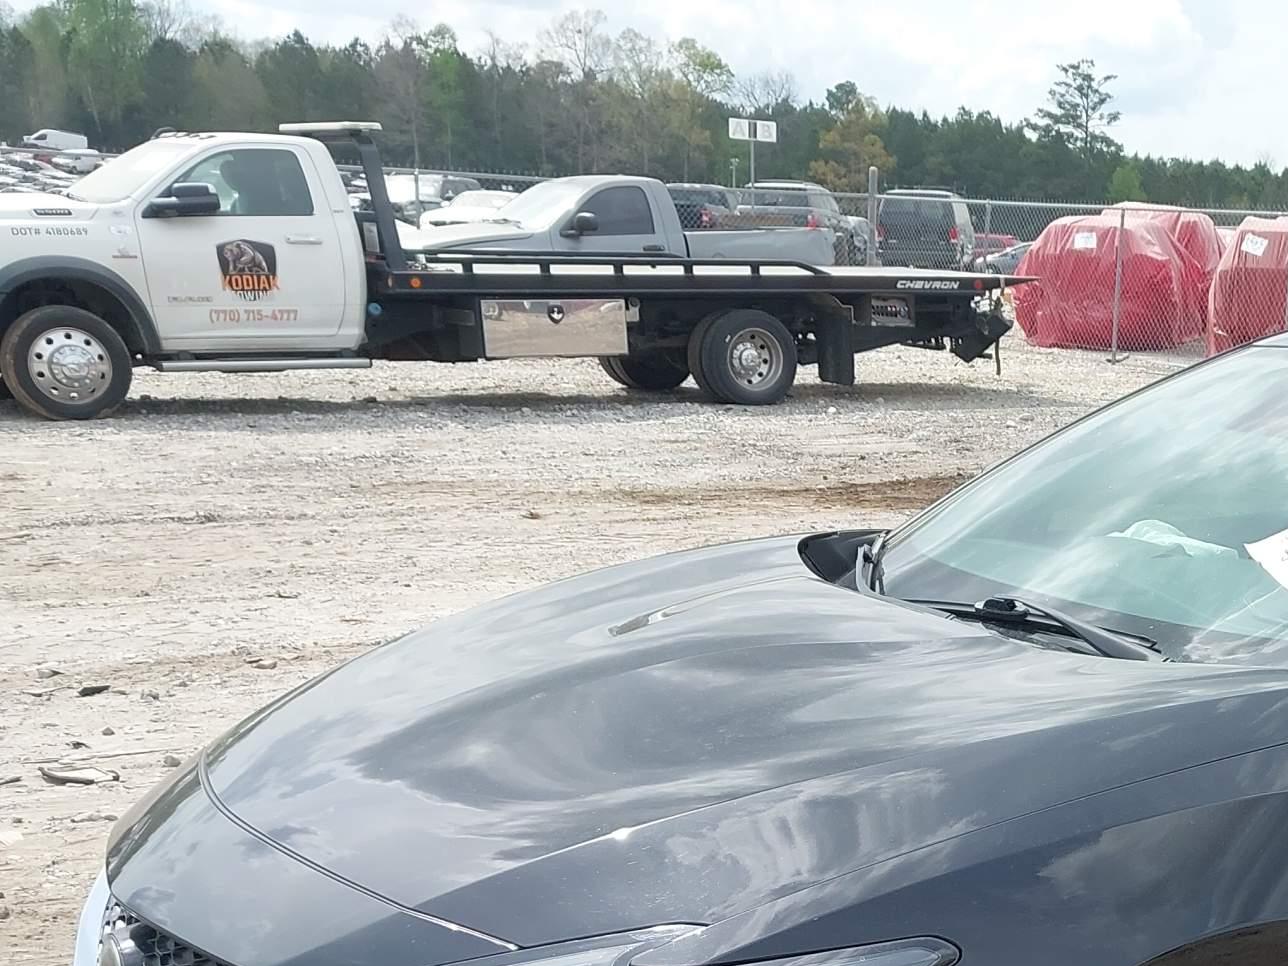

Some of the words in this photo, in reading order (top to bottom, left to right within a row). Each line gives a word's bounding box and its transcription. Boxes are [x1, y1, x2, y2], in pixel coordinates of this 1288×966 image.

[11, 227, 41, 236] DOT#
[222, 274, 280, 290] KODIAK
[896, 281, 960, 289] CHEVRON
[209, 308, 241, 323] (770)
[244, 309, 298, 321] 715-4777
